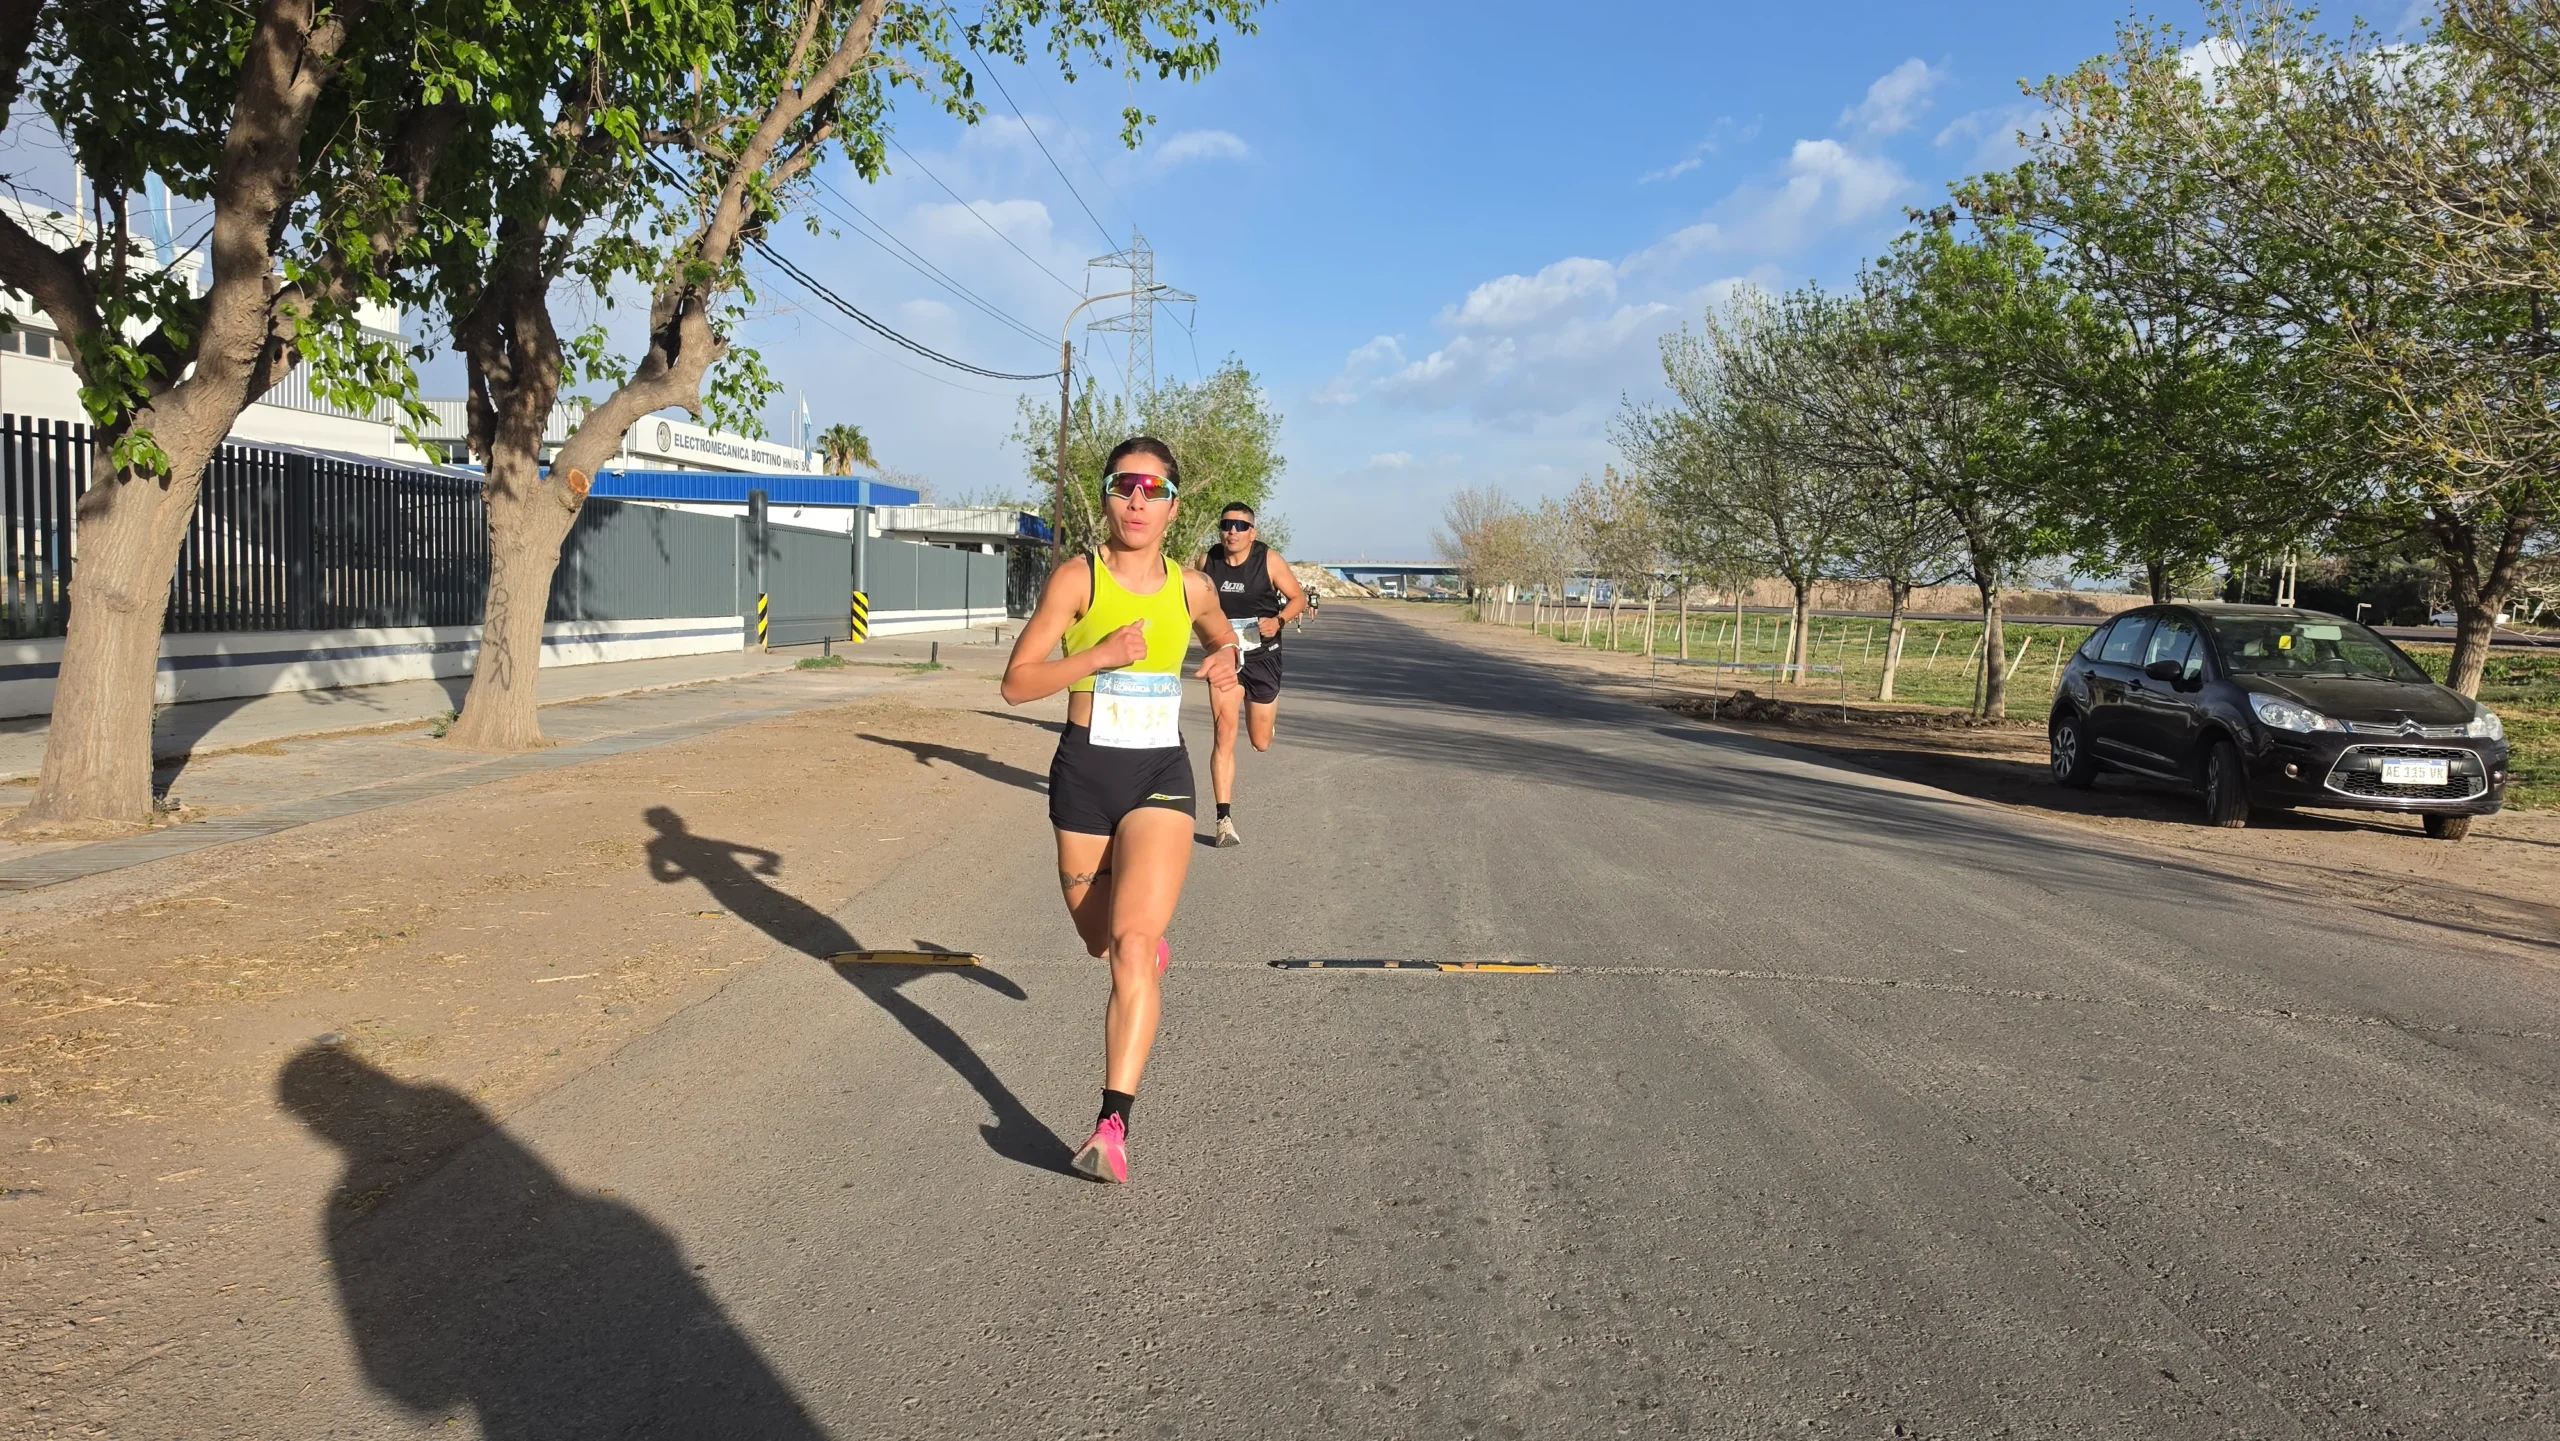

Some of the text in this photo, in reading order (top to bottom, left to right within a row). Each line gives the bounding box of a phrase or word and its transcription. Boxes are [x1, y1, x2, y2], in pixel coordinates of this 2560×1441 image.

[674, 432, 750, 461] ELECTROMECANICA
[751, 449, 782, 467] BOTTINO
[2386, 766, 2400, 778] AE
[2429, 767, 2444, 779] VK
